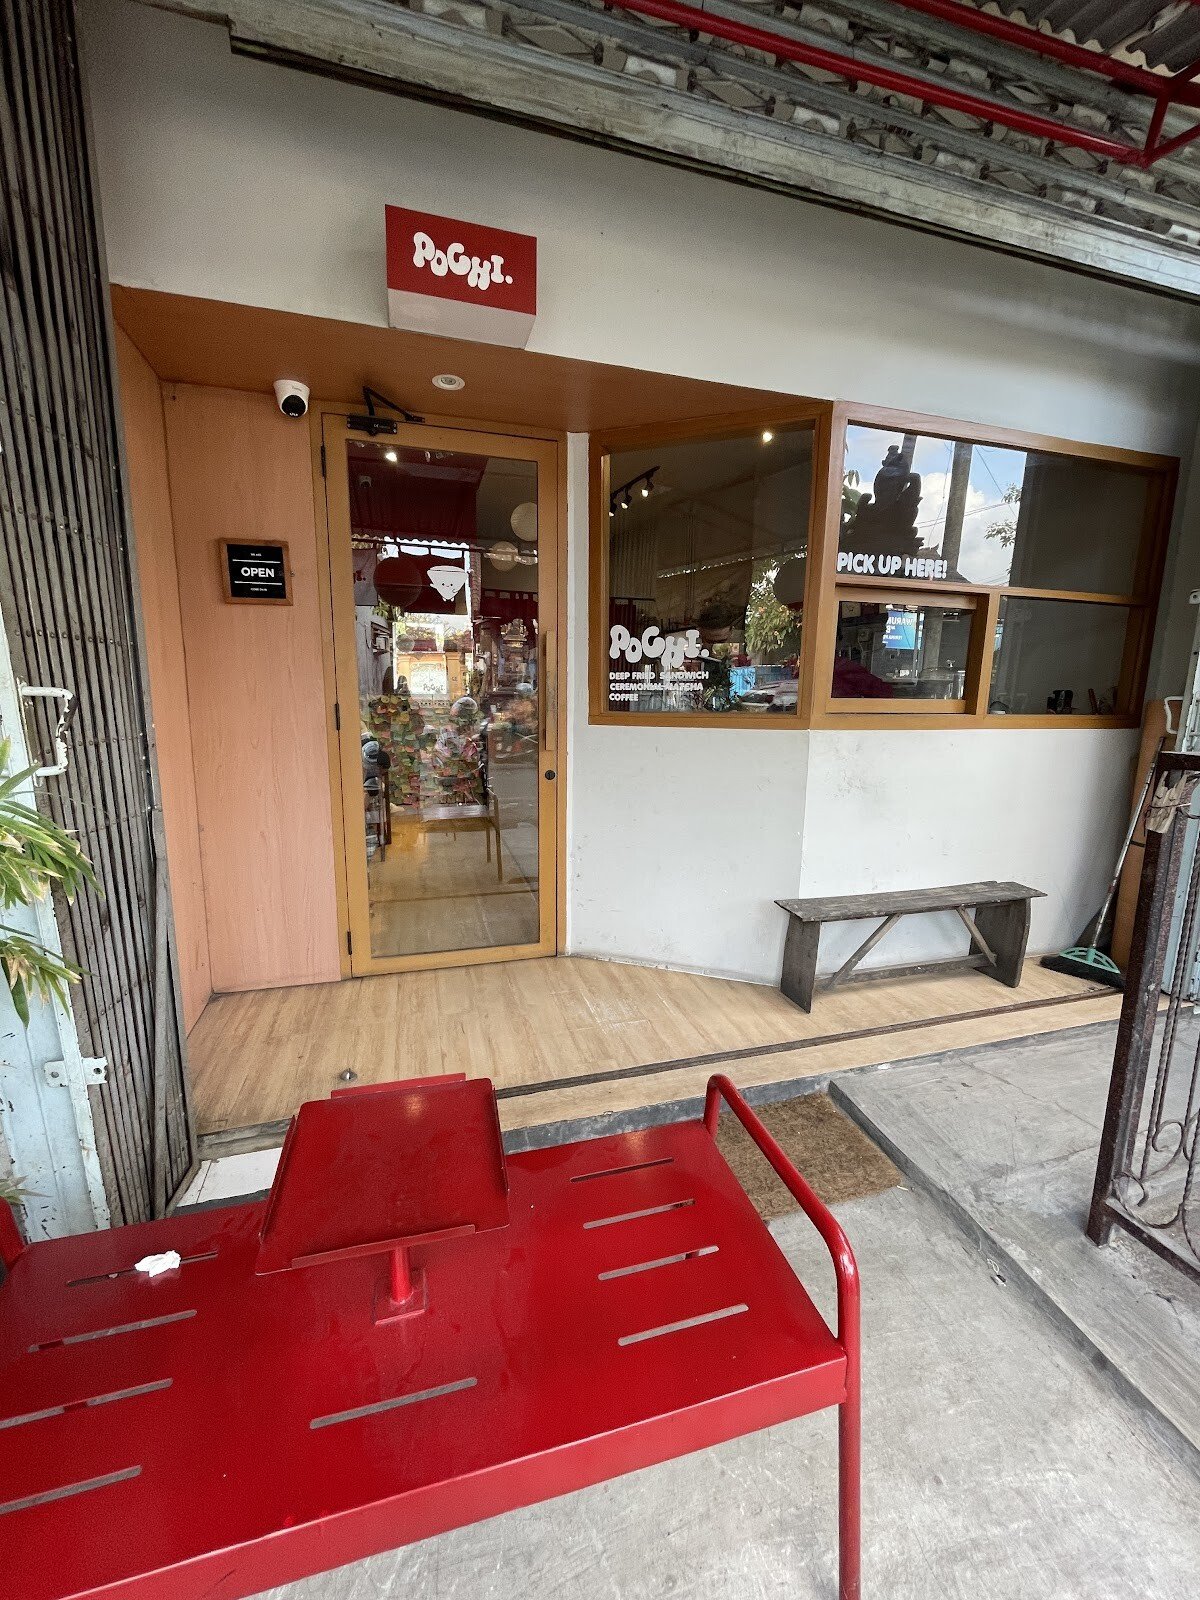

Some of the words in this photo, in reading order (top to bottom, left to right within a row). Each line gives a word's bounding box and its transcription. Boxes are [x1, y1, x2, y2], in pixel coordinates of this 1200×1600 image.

[413, 231, 513, 291] POCHI.
[837, 552, 875, 574] PICK
[878, 554, 902, 575] UP
[904, 557, 948, 579] HERE!
[241, 567, 275, 578] OPEN
[609, 624, 709, 668] POCHI.
[609, 672, 630, 680] DEEP
[632, 671, 655, 680] FRIED
[660, 671, 709, 680] SANDWICH
[610, 682, 663, 691] CEREMONIAL
[664, 682, 704, 691] MATCHA
[609, 693, 639, 701] COFFEE
